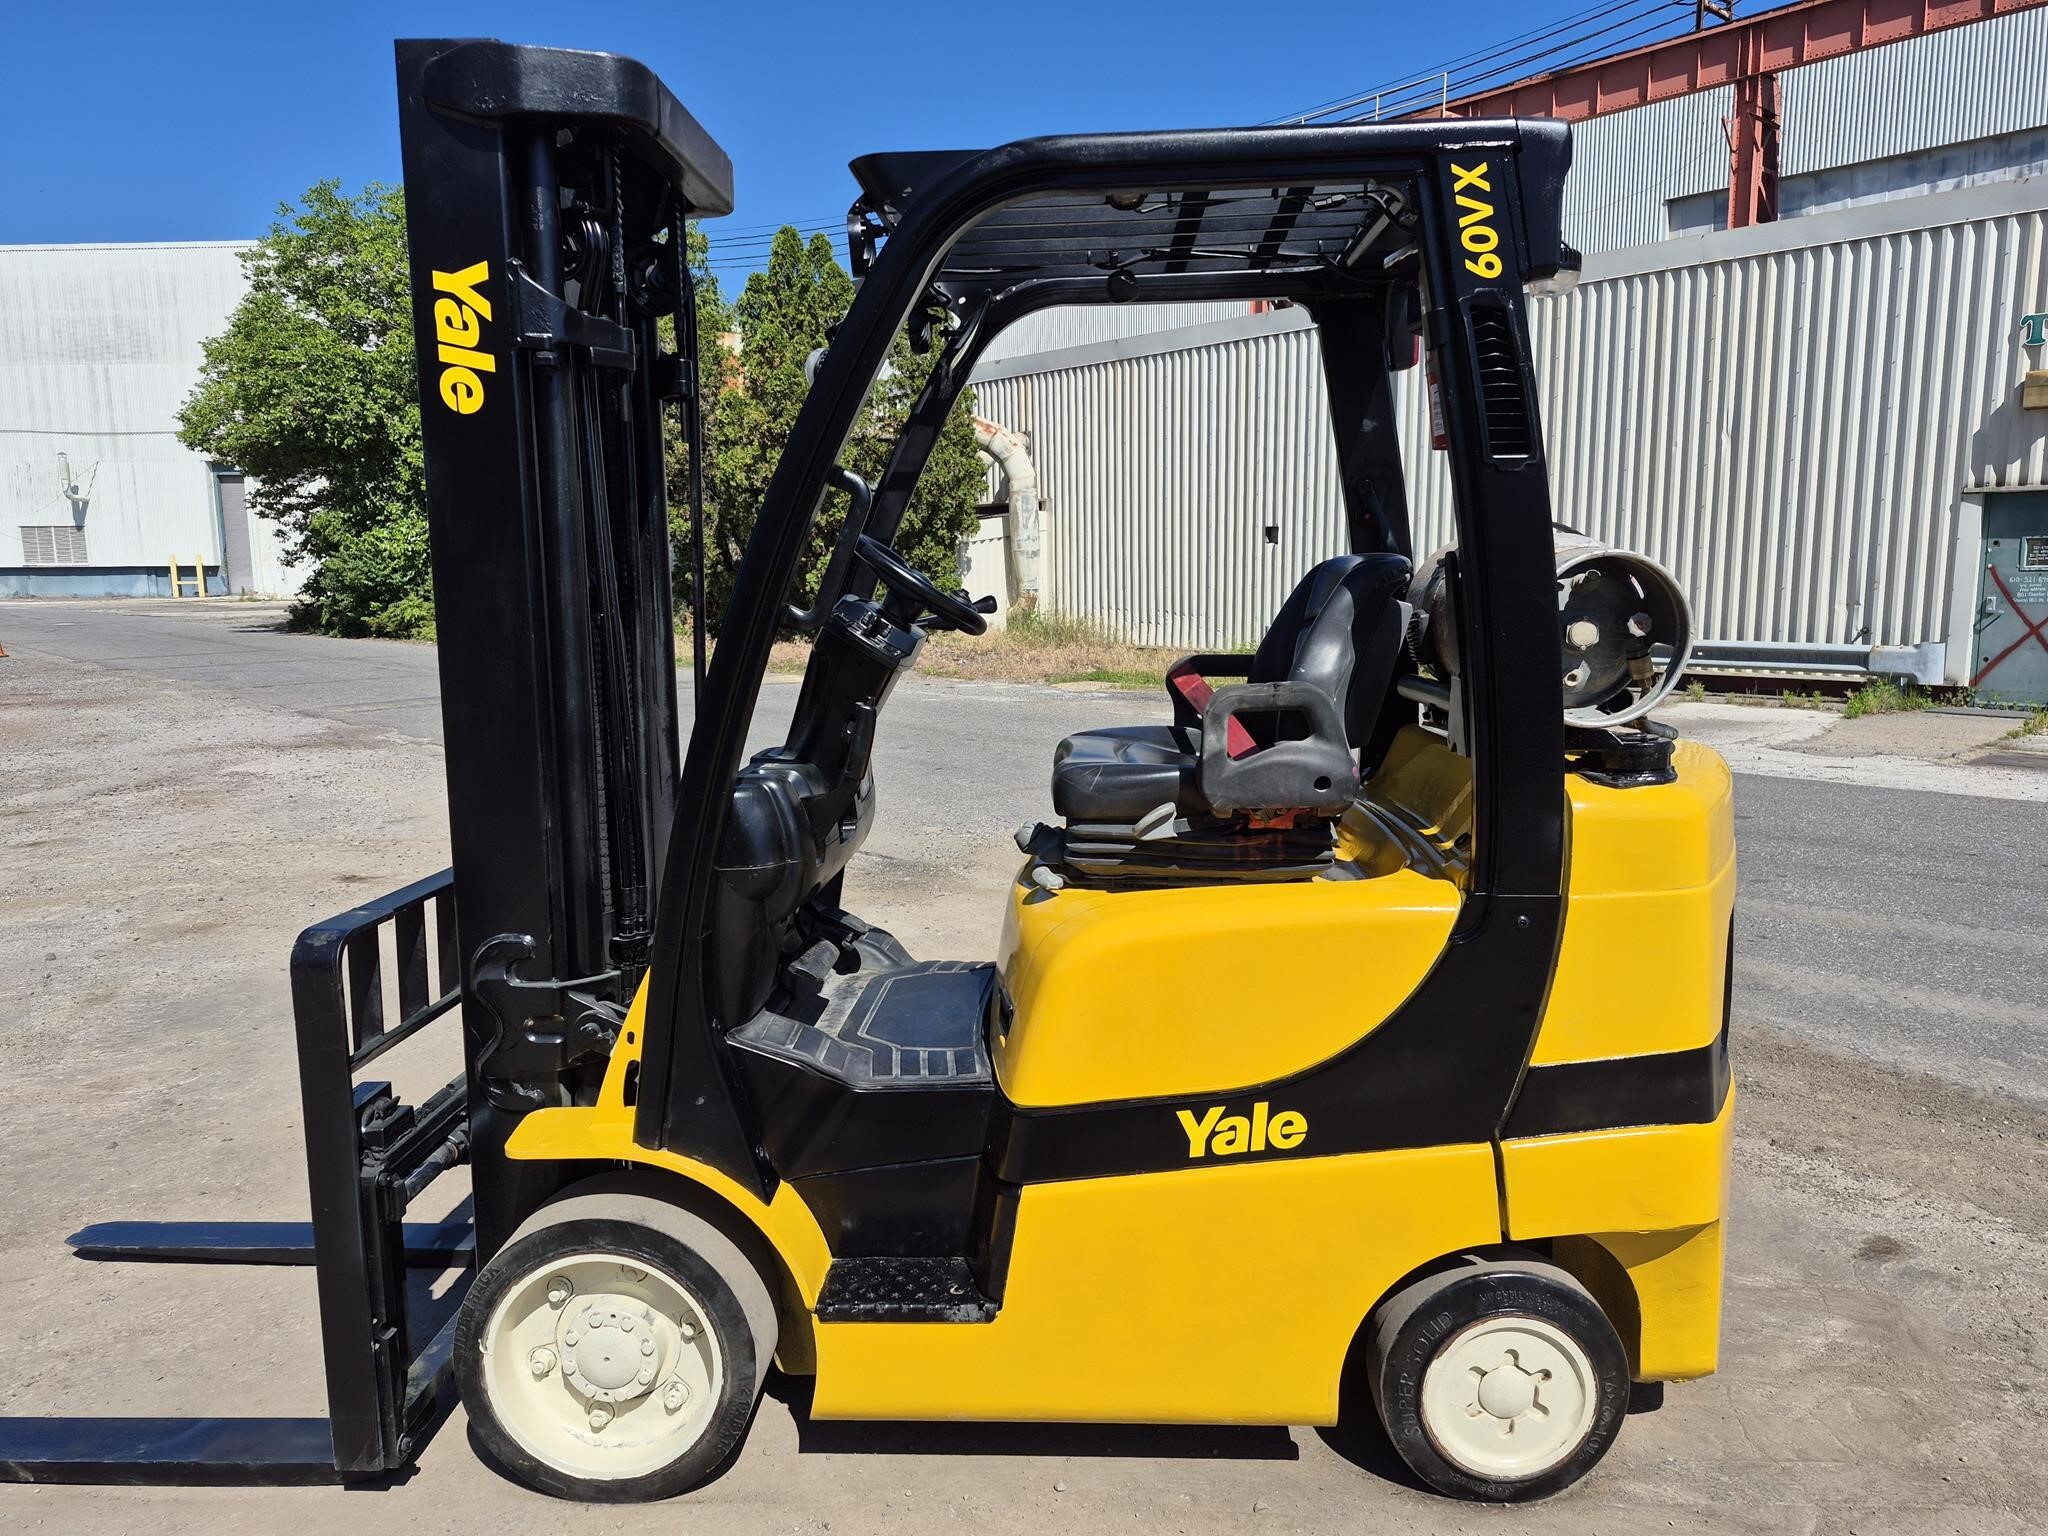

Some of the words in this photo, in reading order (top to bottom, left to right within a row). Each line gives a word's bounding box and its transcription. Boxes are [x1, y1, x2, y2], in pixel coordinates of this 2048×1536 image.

[1451, 163, 1503, 279] 60VX
[431, 260, 497, 415] Yale
[1176, 1102, 1308, 1158] Yale
[1406, 1311, 1453, 1362] SOLID
[1399, 1372, 1421, 1437] SUPER
